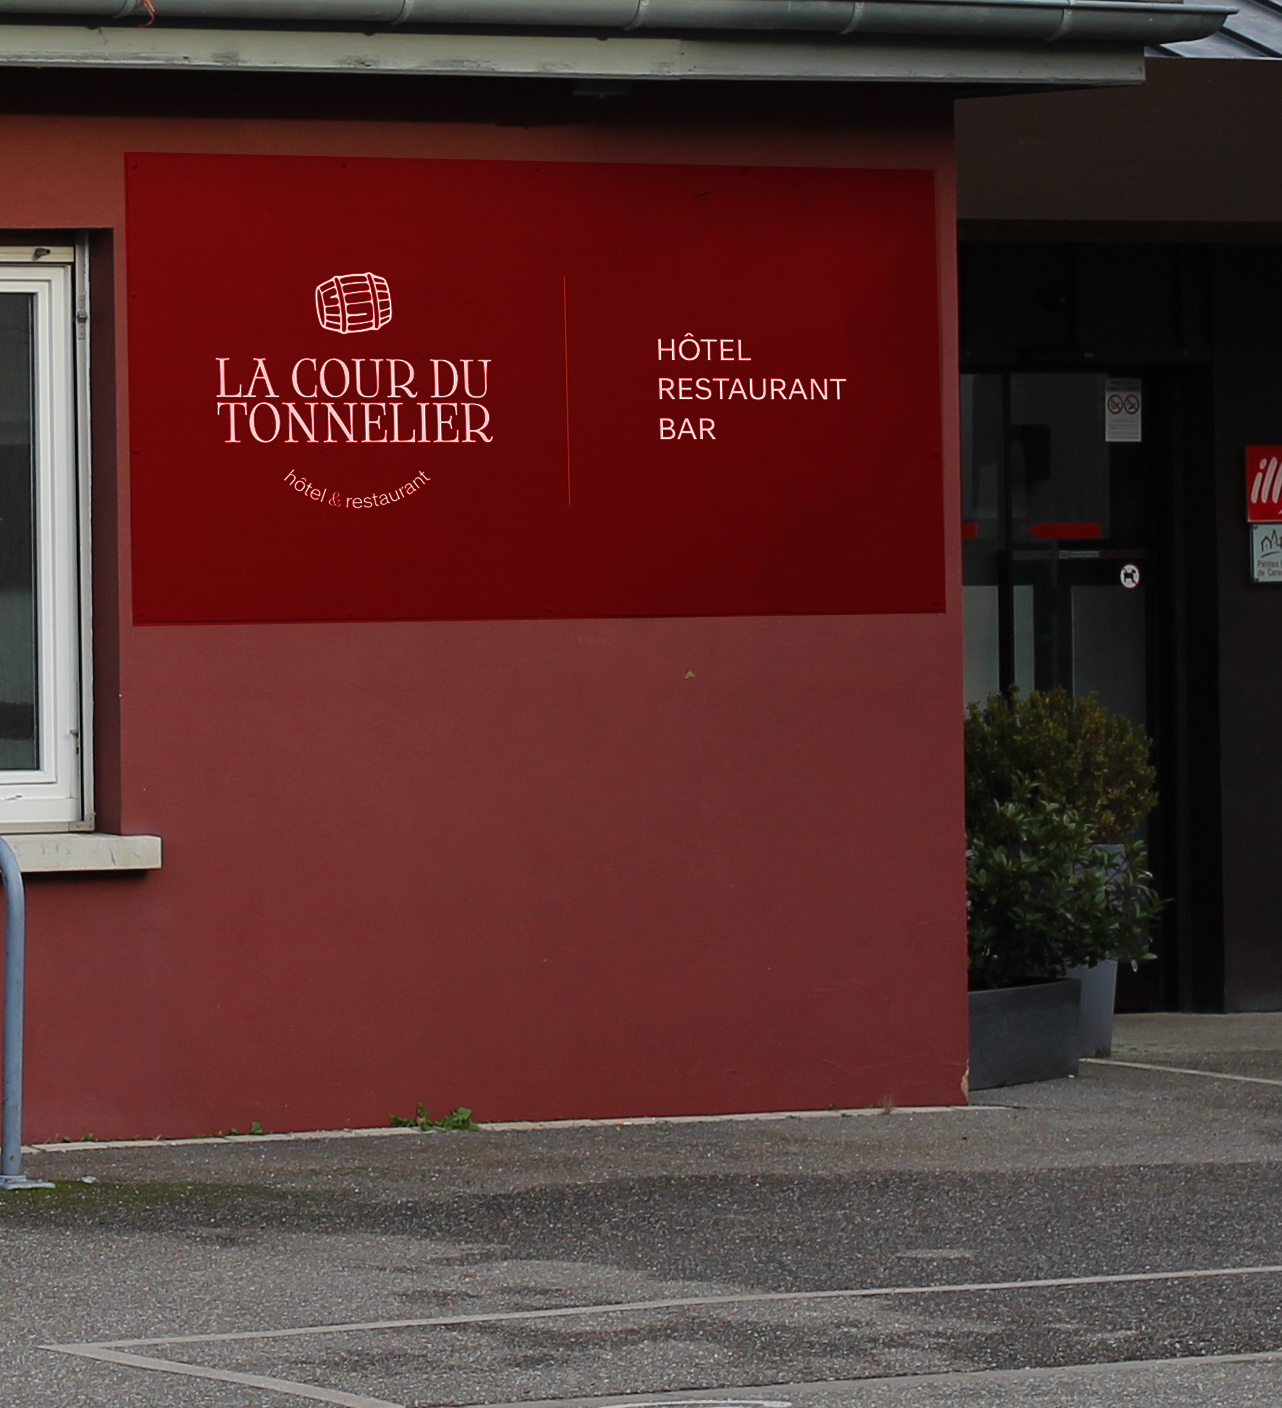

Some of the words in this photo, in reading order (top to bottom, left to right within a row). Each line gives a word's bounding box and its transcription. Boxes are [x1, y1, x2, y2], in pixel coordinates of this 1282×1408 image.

[657, 332, 752, 361] HÔTEL
[215, 357, 280, 398] LA
[291, 358, 418, 399] COUR
[429, 358, 492, 399] DU
[658, 377, 847, 401] RESTAURANT
[217, 401, 494, 444] TONNELIER
[659, 417, 717, 441] BAR
[283, 469, 327, 503] hôtel
[328, 491, 342, 507] &
[345, 470, 431, 509] restaurant
